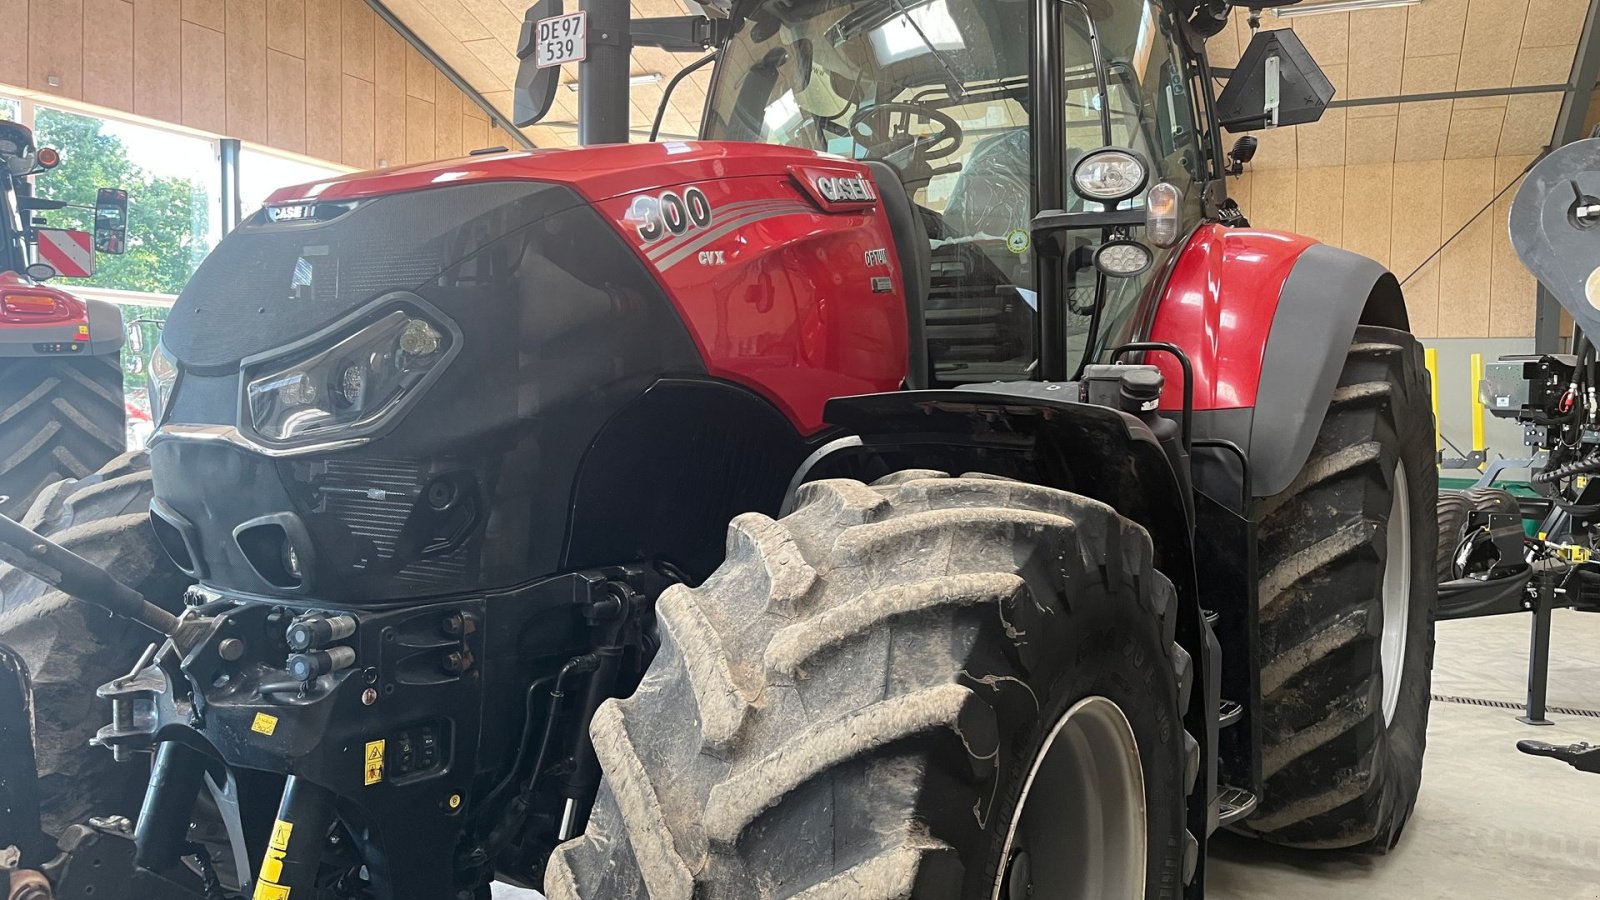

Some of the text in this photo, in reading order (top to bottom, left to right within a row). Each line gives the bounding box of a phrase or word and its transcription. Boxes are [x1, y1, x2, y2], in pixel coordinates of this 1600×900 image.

[546, 39, 574, 61] 539
[632, 186, 712, 244] 300
[697, 250, 726, 266] CVX
